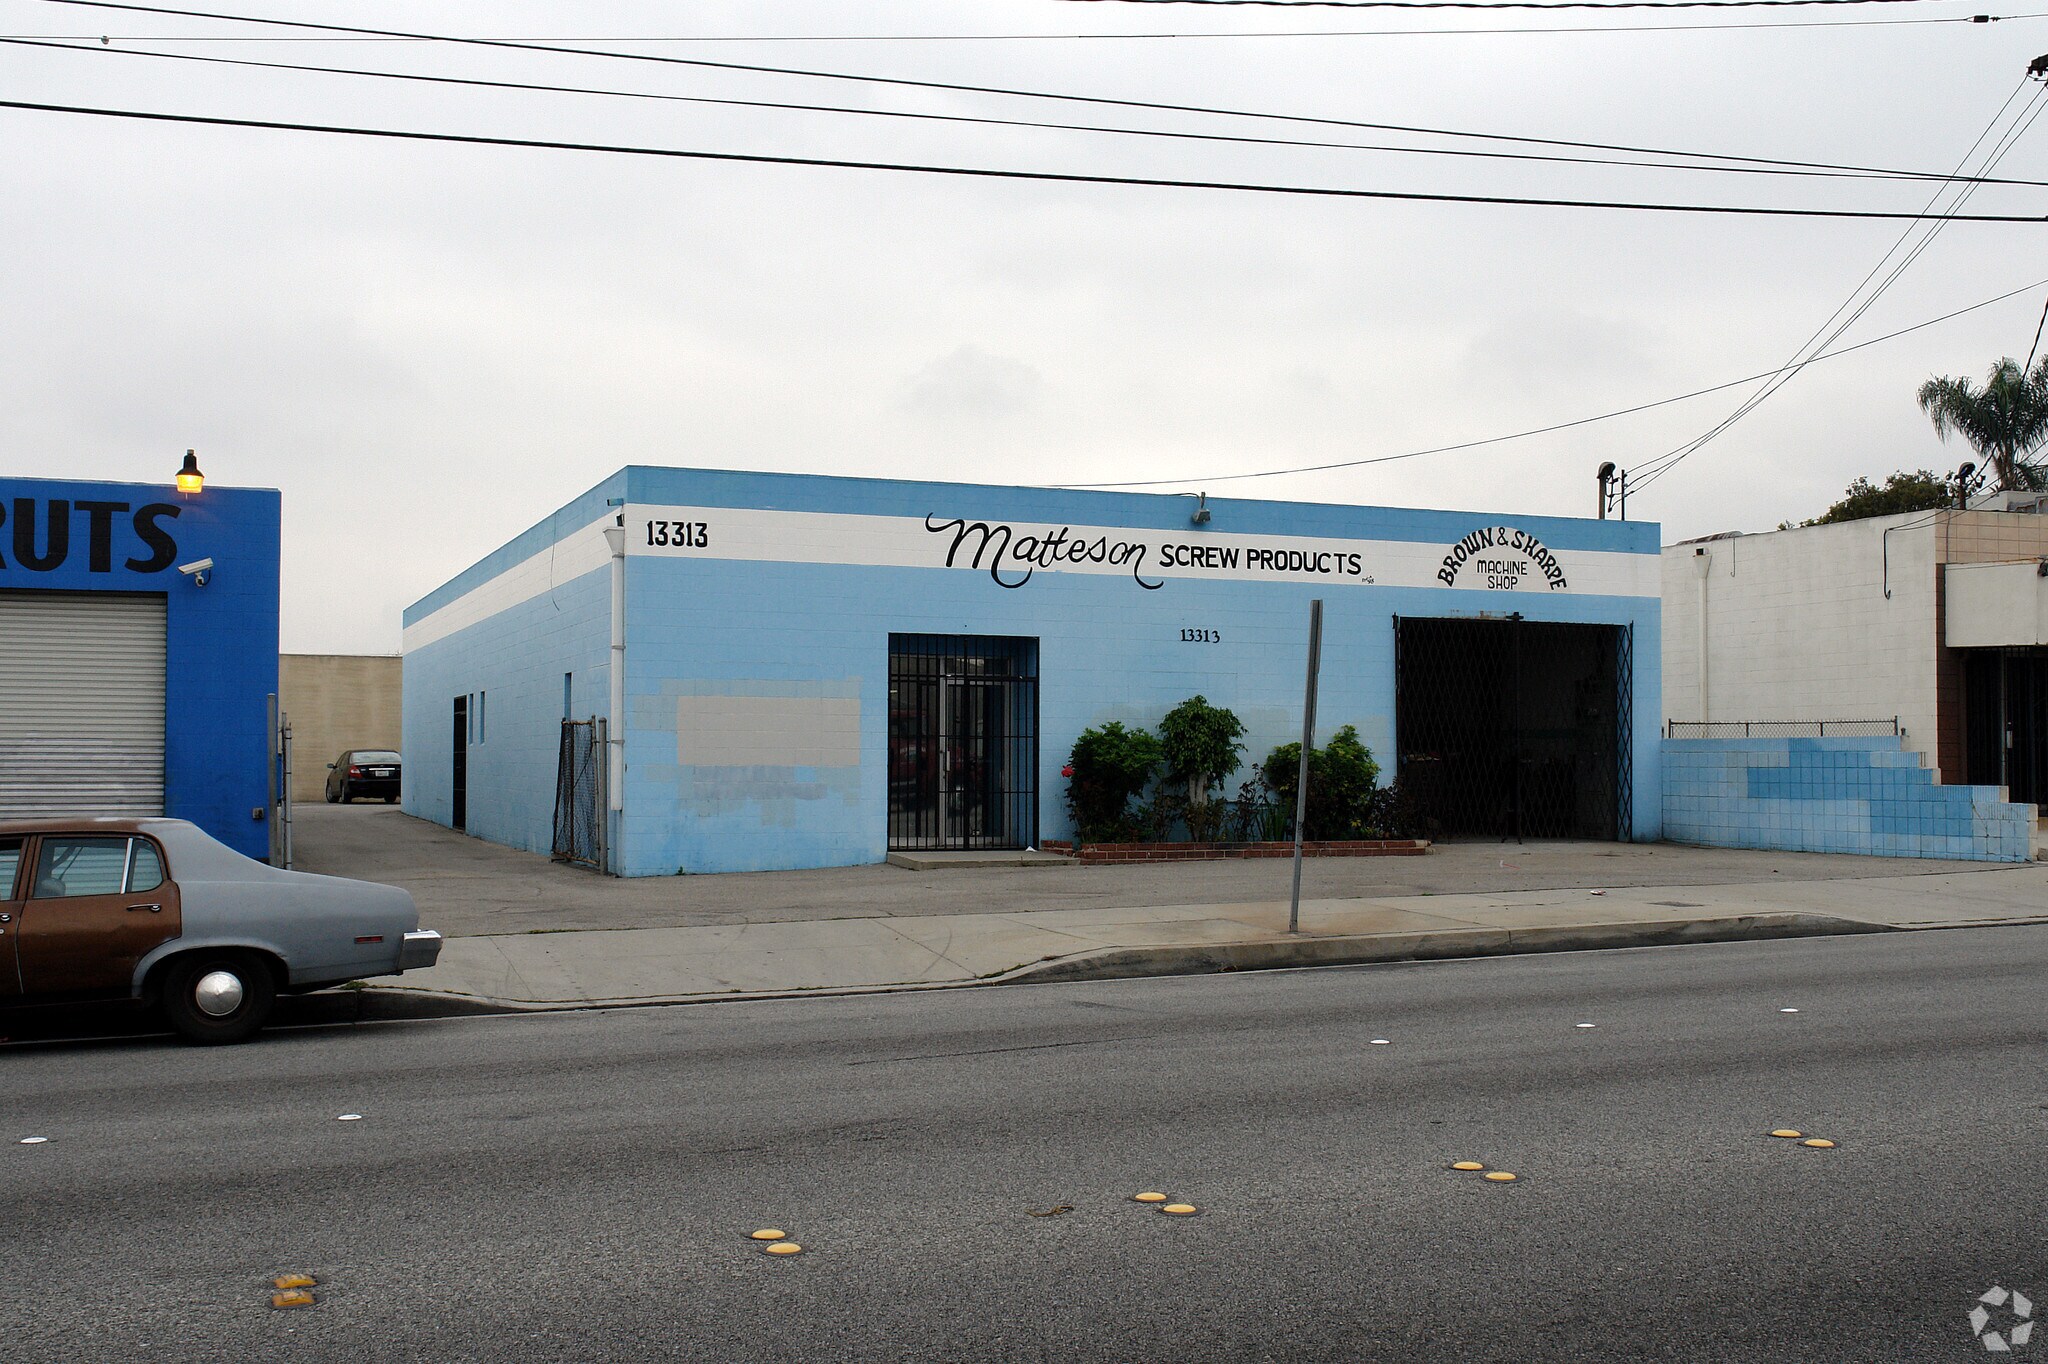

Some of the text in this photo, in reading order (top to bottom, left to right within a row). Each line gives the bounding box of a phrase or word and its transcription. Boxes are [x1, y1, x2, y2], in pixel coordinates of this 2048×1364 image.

[0, 498, 182, 573] UTS
[646, 520, 708, 548] 13313
[925, 512, 1362, 590] Matteson SCREW PRODUCTS
[1437, 526, 1568, 591] BROWN & SHARPE
[1476, 559, 1528, 576] MACHINE
[1487, 575, 1519, 590] SHOP
[1180, 628, 1221, 644] 13313
